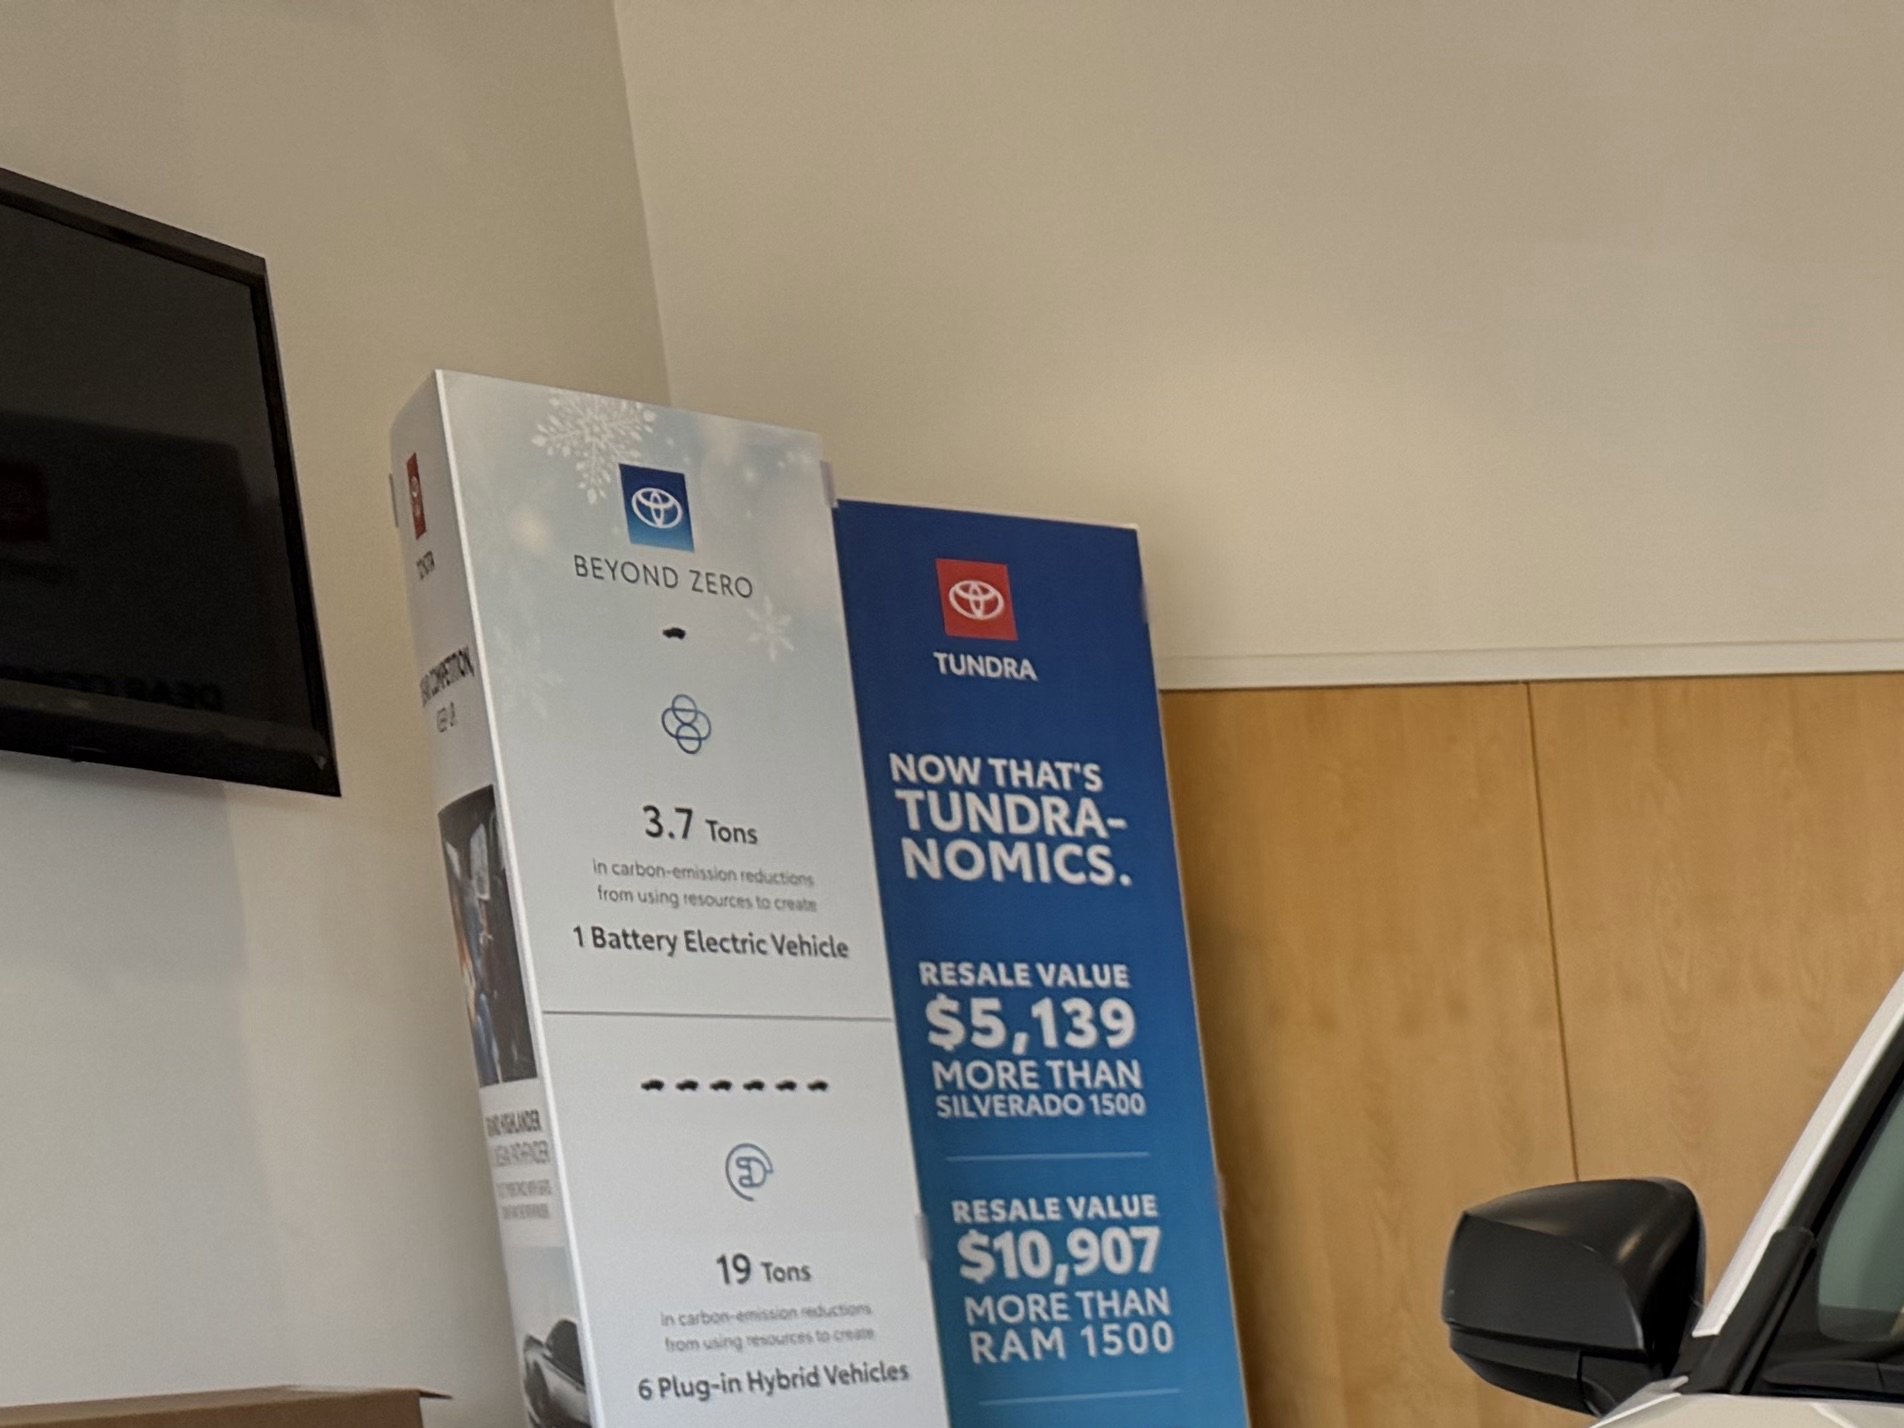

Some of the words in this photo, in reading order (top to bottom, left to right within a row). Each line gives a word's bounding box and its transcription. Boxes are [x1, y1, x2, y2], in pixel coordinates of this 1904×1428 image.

[574, 554, 679, 588] BEYOND
[689, 569, 754, 598] ZERO
[933, 651, 1038, 681] TUNDRA
[889, 753, 981, 786] NOW
[988, 758, 1103, 792] THAT'S
[642, 804, 693, 840] 3.7
[705, 818, 758, 845] Tons
[895, 789, 1128, 839] TUNDRA-
[612, 860, 737, 882] carbon-emission
[740, 869, 814, 887] reductions
[901, 836, 1132, 886] NOMICS.
[597, 885, 634, 902] from
[638, 889, 680, 909] using
[683, 892, 753, 909] resources
[756, 896, 770, 910] to
[774, 898, 818, 913] create
[573, 926, 584, 947] 1
[591, 926, 677, 958] Battery
[683, 929, 767, 955] Electric
[770, 933, 849, 958] Vehicle
[918, 961, 1033, 987] RESALE
[1035, 963, 1131, 988] VALUE
[925, 992, 1136, 1056] $5,139
[931, 1060, 1041, 1091] MORE
[1045, 1059, 1143, 1090] THAN
[935, 1093, 1085, 1119] SILVERADO
[1088, 1092, 1147, 1116] 1500
[951, 1197, 1063, 1224] RESALE
[1065, 1194, 1158, 1220] VALUE
[716, 1253, 752, 1285] 19
[761, 1261, 812, 1284] Tons
[957, 1226, 1161, 1286] $10,907
[678, 1305, 798, 1327] carbon-emission
[801, 1303, 872, 1319] reductions
[963, 1291, 1071, 1326] MORE
[1075, 1286, 1171, 1320] THAN
[664, 1335, 699, 1352] from
[703, 1333, 743, 1353] using
[746, 1330, 813, 1347] resources
[815, 1328, 831, 1343] to
[833, 1326, 875, 1342] create
[969, 1326, 1066, 1365] RAM
[1081, 1320, 1174, 1359] 1500
[638, 1378, 653, 1401] 6
[658, 1372, 742, 1402] Plug-in
[746, 1367, 820, 1397] Hybrid
[823, 1360, 910, 1386] Vehicles
